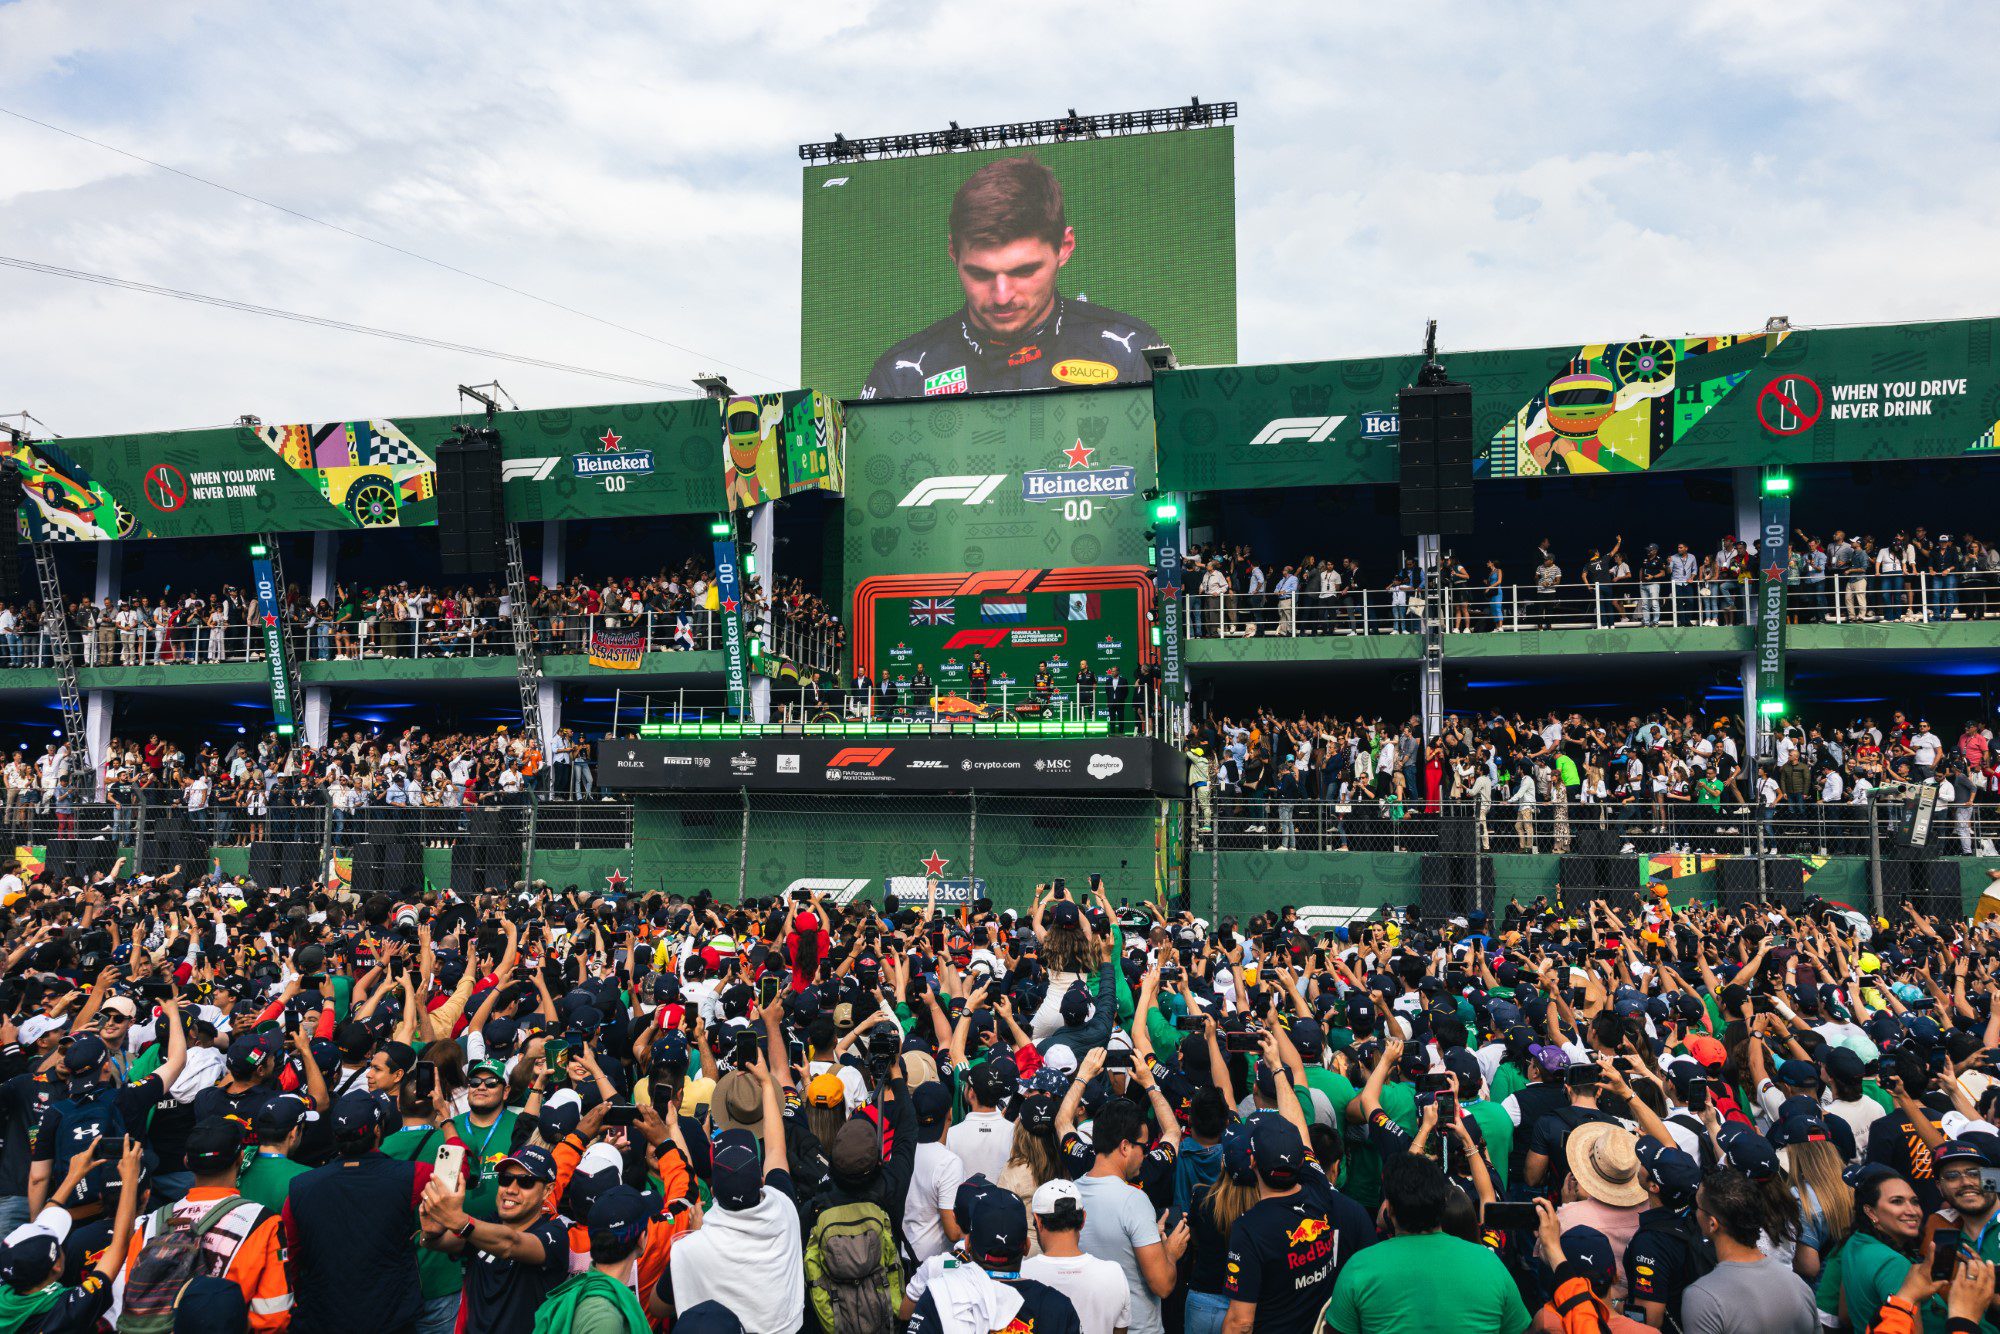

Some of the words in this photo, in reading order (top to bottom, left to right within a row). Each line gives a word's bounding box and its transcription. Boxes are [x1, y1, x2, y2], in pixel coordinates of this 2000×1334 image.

[927, 367, 965, 387] TAG
[1069, 366, 1109, 378] RAUCH
[1832, 383, 1878, 401] WHEN
[1882, 381, 1917, 399] YOU
[1920, 378, 1967, 396] DRIVE
[1830, 402, 1879, 420] NEVER
[1884, 400, 1932, 417] DRINK
[577, 456, 649, 472] Heineken
[190, 471, 221, 486] WHEN
[222, 470, 245, 484] YOU
[246, 468, 276, 482] DRIVE
[605, 476, 626, 492] 0.0
[1029, 474, 1129, 495] Heineken
[192, 486, 224, 500] NEVER
[226, 484, 257, 498] DRINK
[1064, 500, 1092, 521] 0.0
[1765, 524, 1784, 548] 0.0
[1161, 547, 1176, 568] 0.0
[719, 563, 734, 584] 0.0
[259, 580, 272, 599] 0.0
[1761, 586, 1781, 673] Heineken
[1163, 603, 1179, 684] Heineken
[726, 616, 743, 692] Heineken
[268, 630, 286, 701] Heineken
[617, 760, 645, 768] ROLEX
[664, 756, 692, 764] PIRELLI
[974, 761, 1021, 770] crypto.com
[1046, 760, 1072, 768] MSC
[1287, 1245, 1316, 1270] Red
[1295, 1266, 1326, 1290] Mobil
